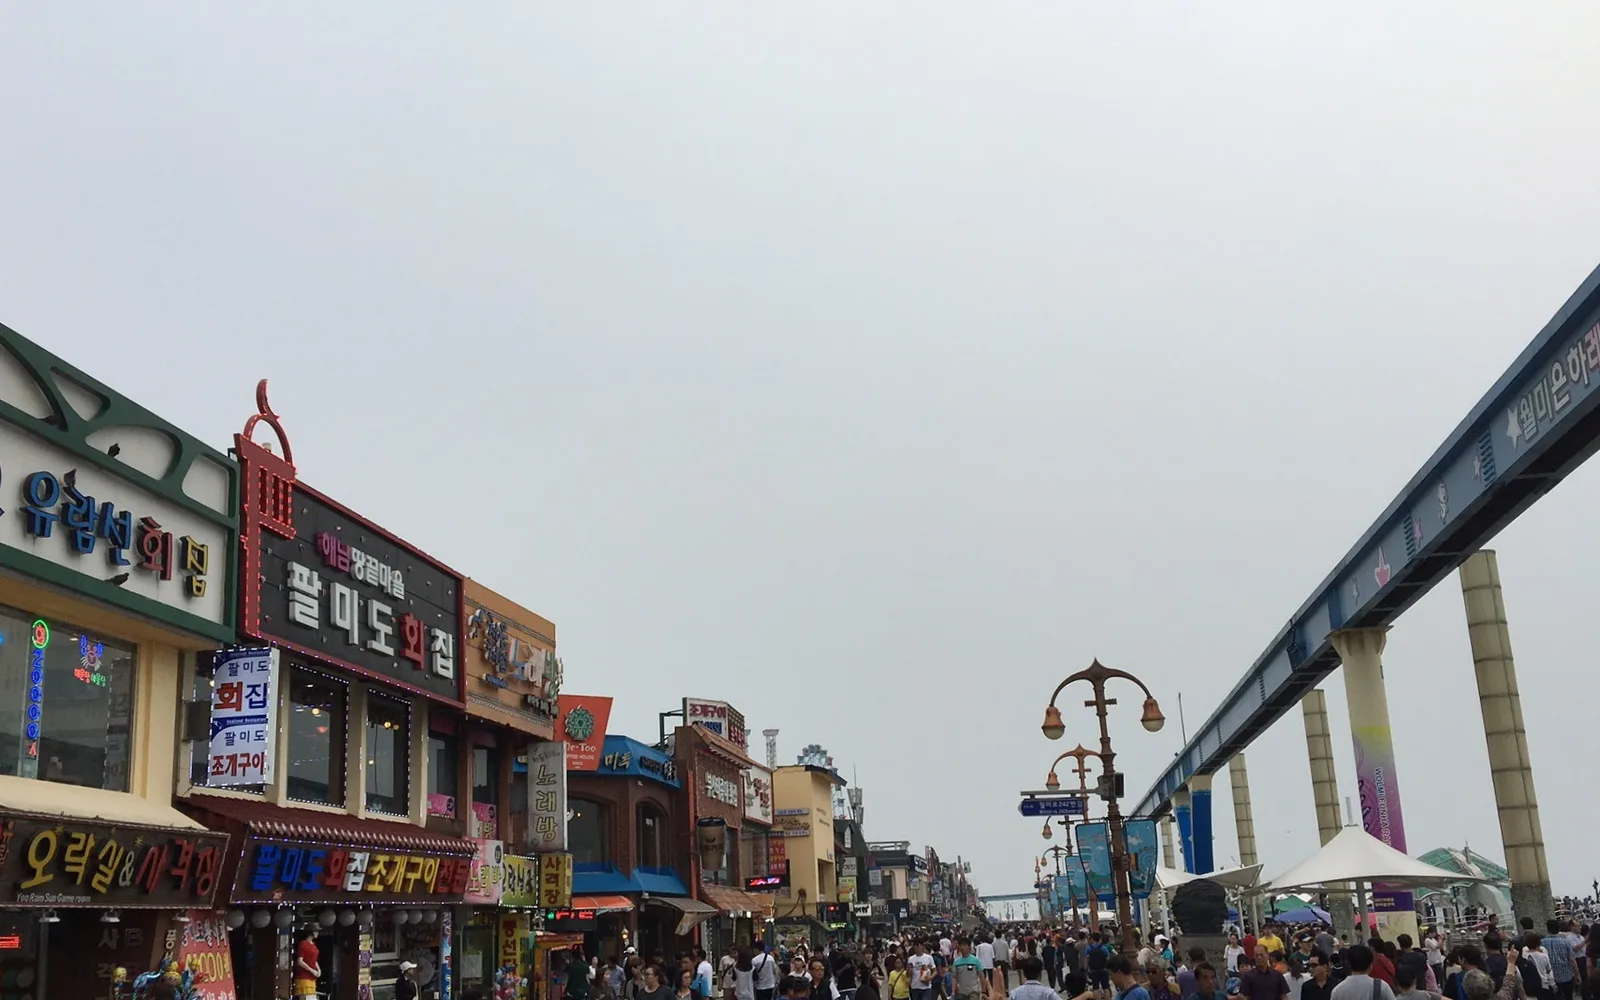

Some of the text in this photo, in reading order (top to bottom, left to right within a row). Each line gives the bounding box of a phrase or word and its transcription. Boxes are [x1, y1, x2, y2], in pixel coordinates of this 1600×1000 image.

[228, 660, 268, 677] 팔미도
[214, 682, 269, 712] 회집
[224, 729, 266, 747] 팔미도
[211, 752, 265, 777] 조개구이
[1374, 766, 1386, 798] WOLMI
[536, 764, 558, 842] 노래방
